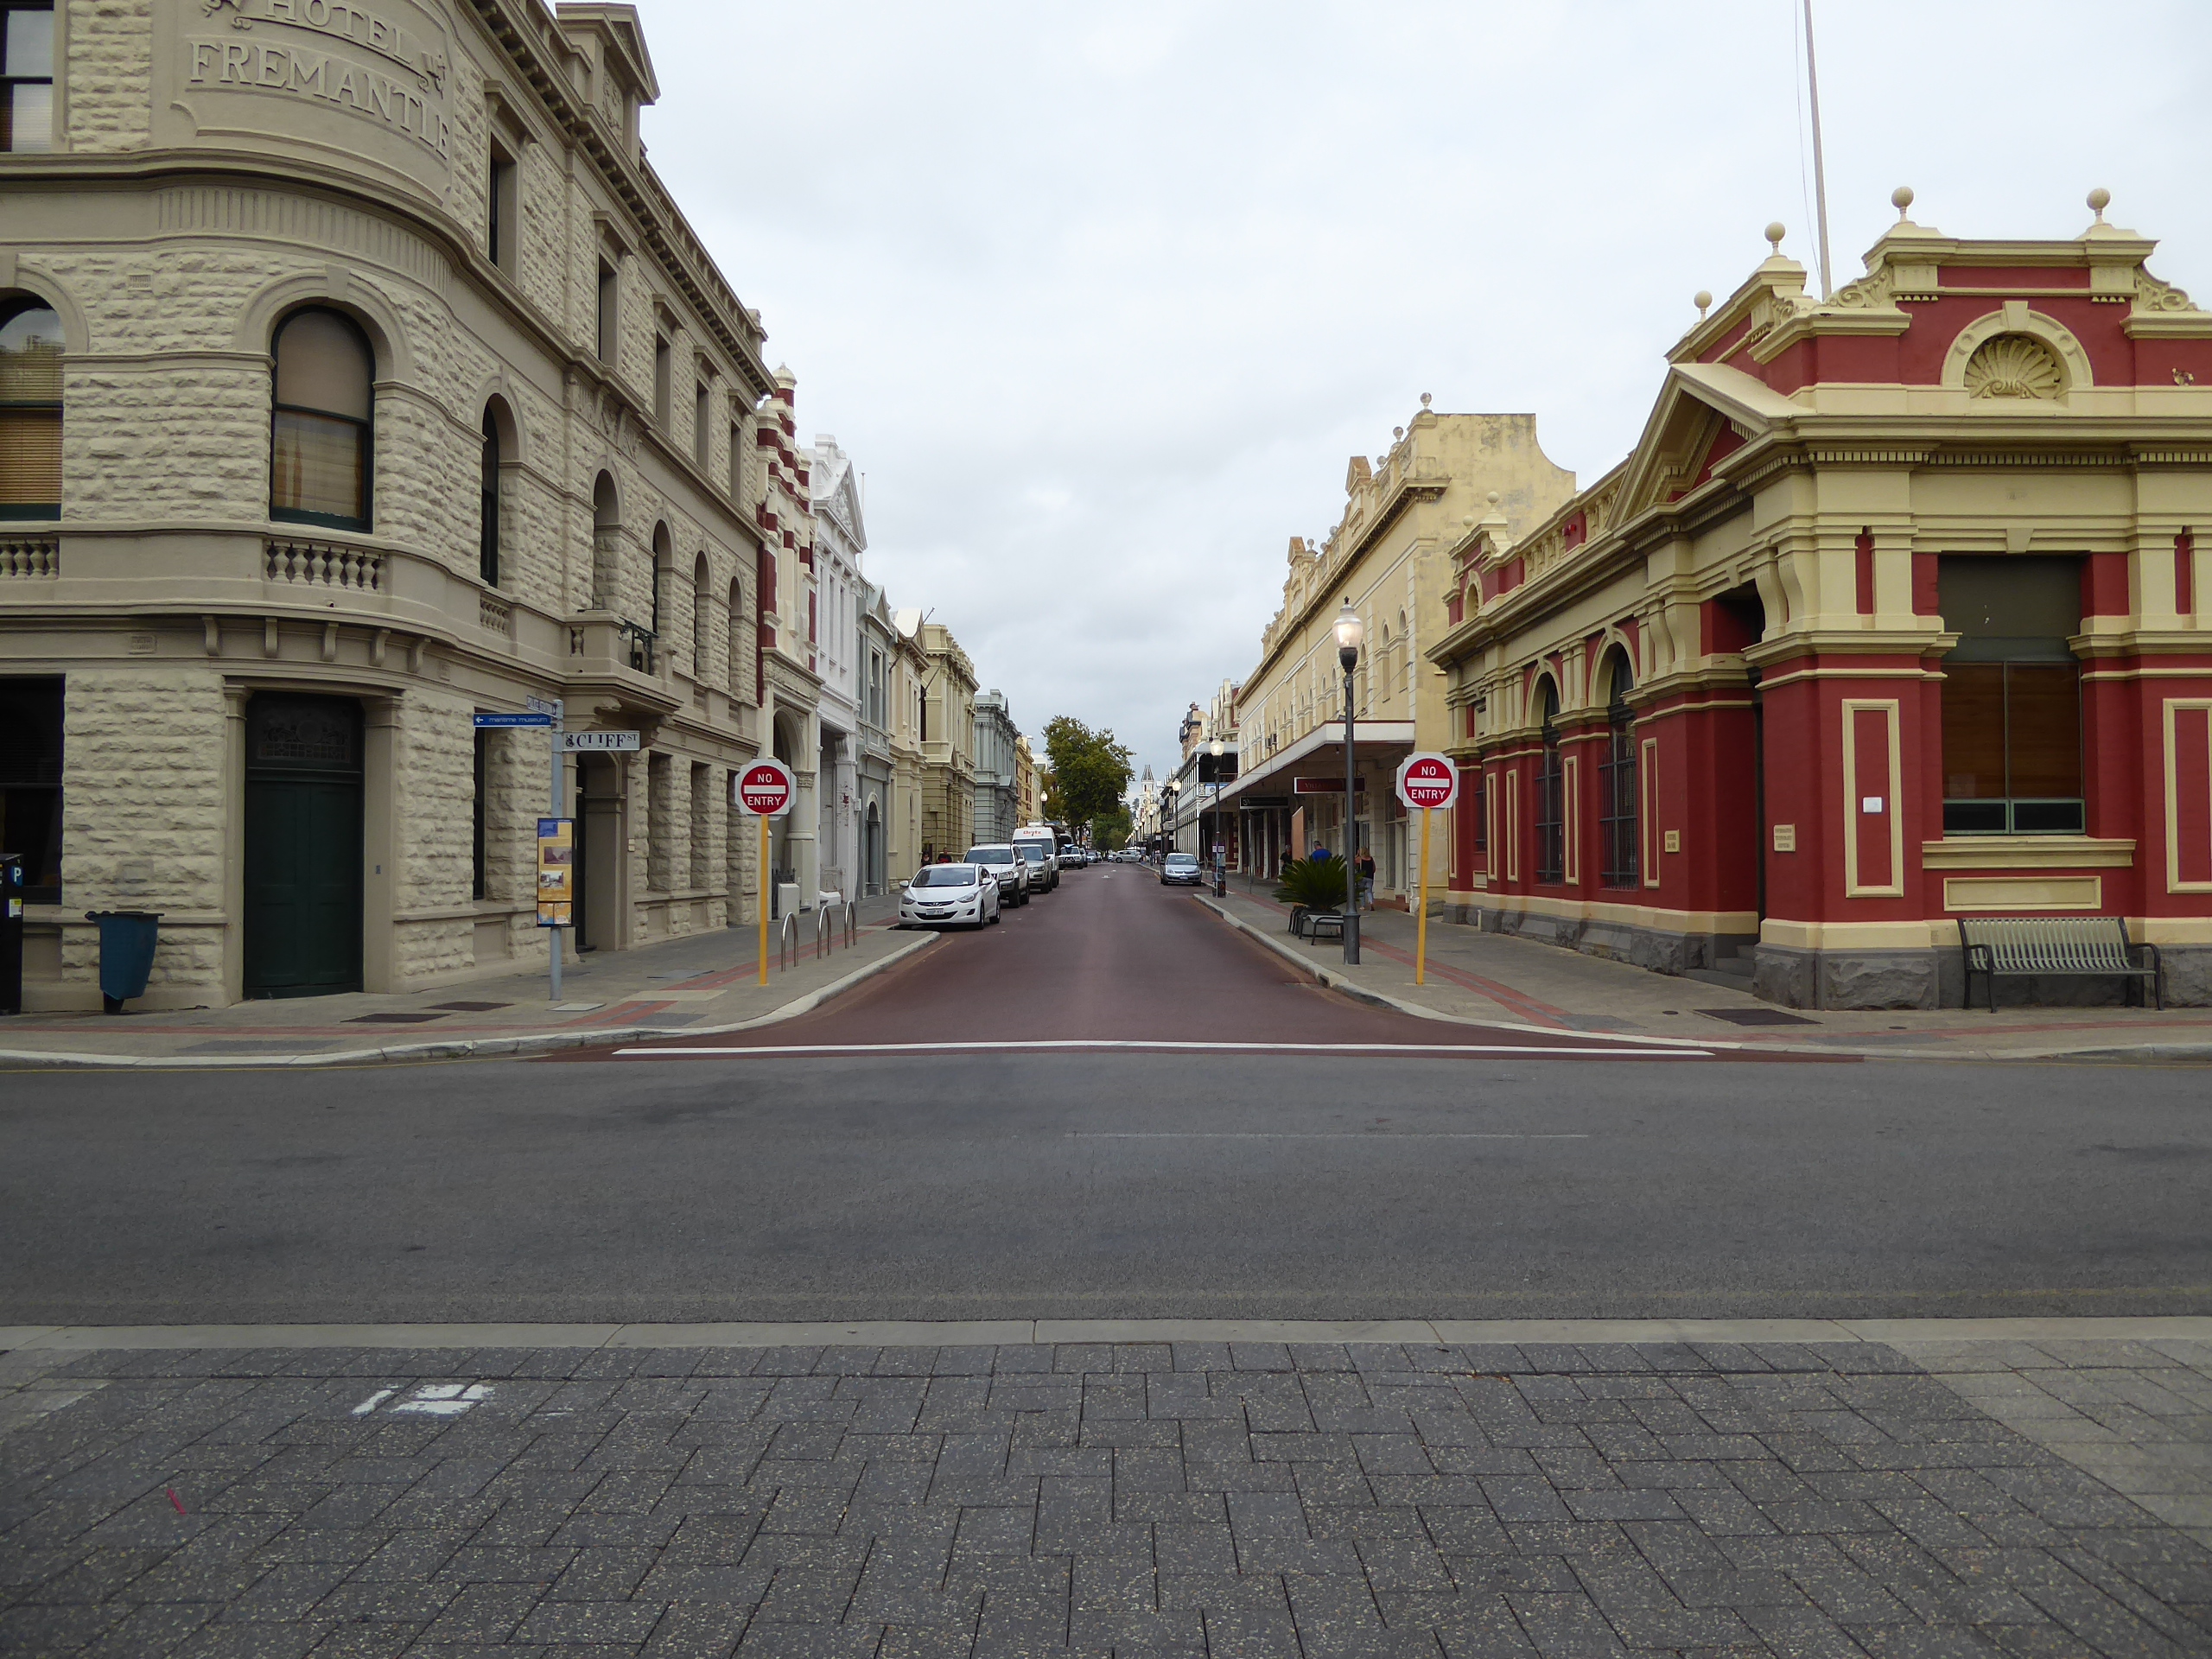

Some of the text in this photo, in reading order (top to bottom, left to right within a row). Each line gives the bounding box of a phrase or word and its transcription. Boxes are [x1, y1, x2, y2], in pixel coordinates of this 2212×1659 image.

[264, 0, 414, 66] HOTEL
[189, 41, 450, 161] FREMANTLE
[1421, 766, 1436, 776] NO
[757, 773, 772, 783] NO
[1411, 789, 1446, 799] ENTRY
[747, 796, 782, 806] ENTRY
[14, 867, 22, 882] P
